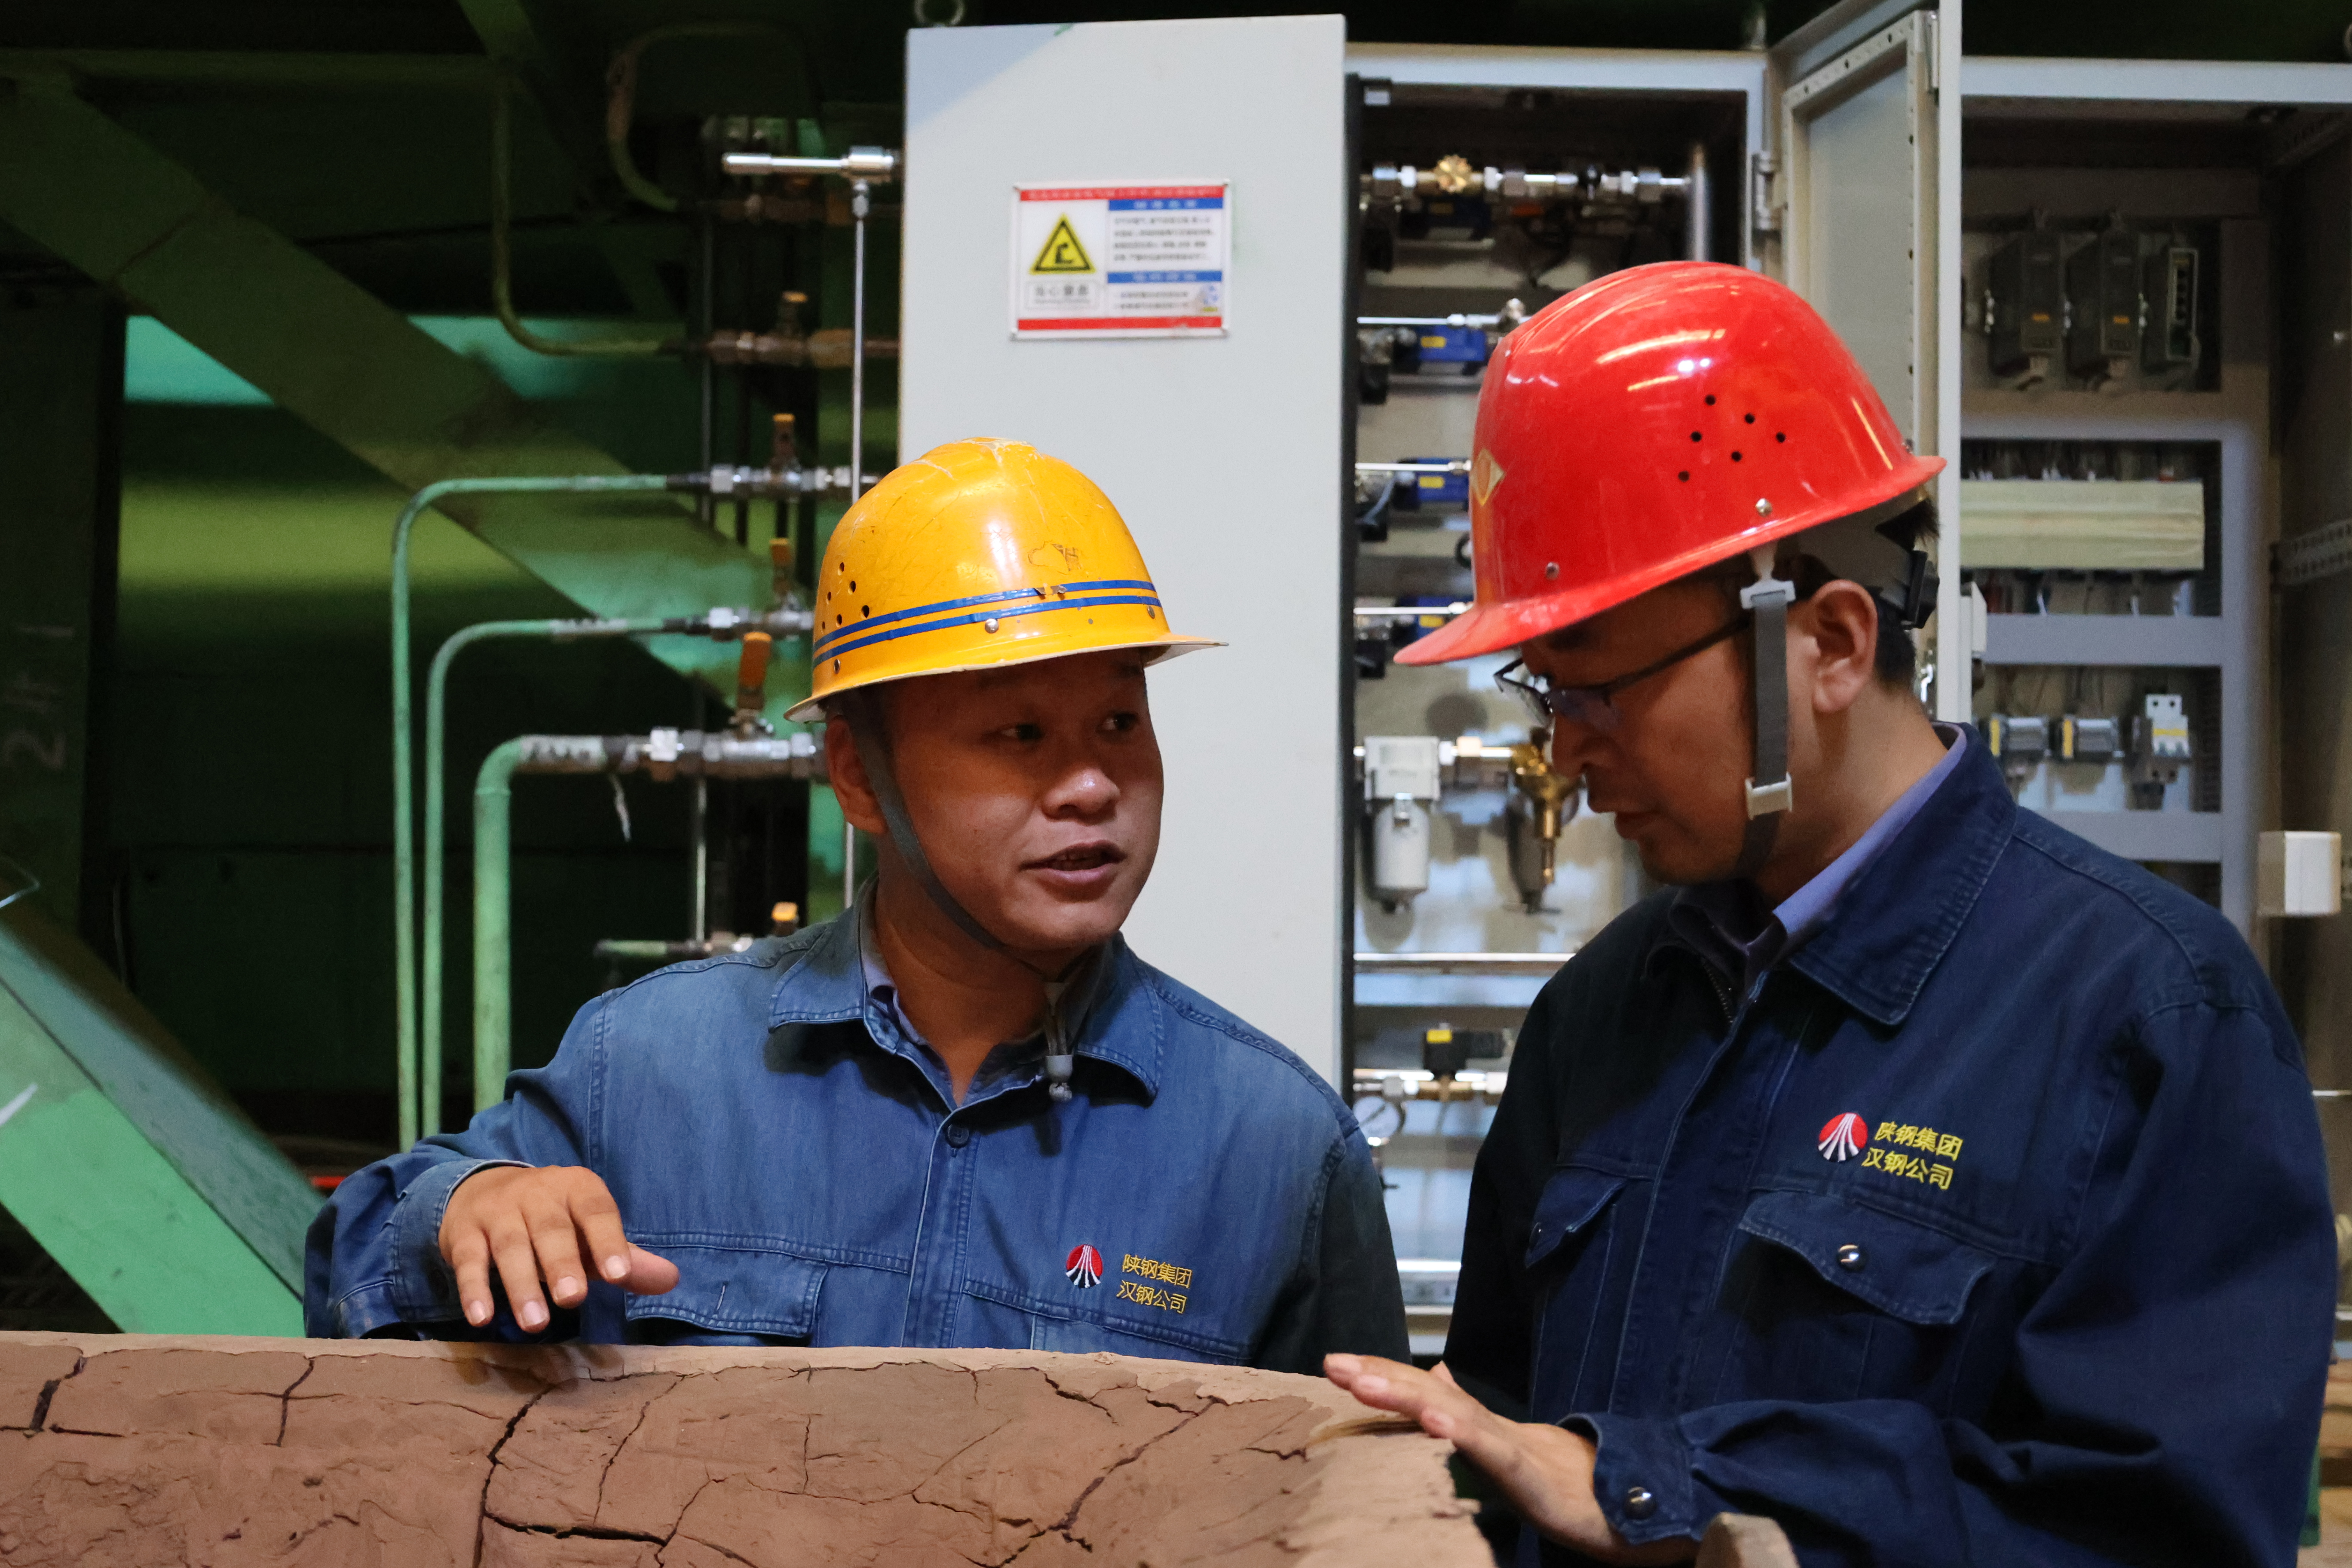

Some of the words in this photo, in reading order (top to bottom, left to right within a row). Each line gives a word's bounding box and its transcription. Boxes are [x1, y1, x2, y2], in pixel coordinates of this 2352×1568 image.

[1874, 1121, 1963, 1161] 陕钢集团
[1861, 1147, 1954, 1190] 汉钢公司
[1122, 1254, 1193, 1288] 陕钢集团
[1116, 1280, 1188, 1314] 汉钢公司
